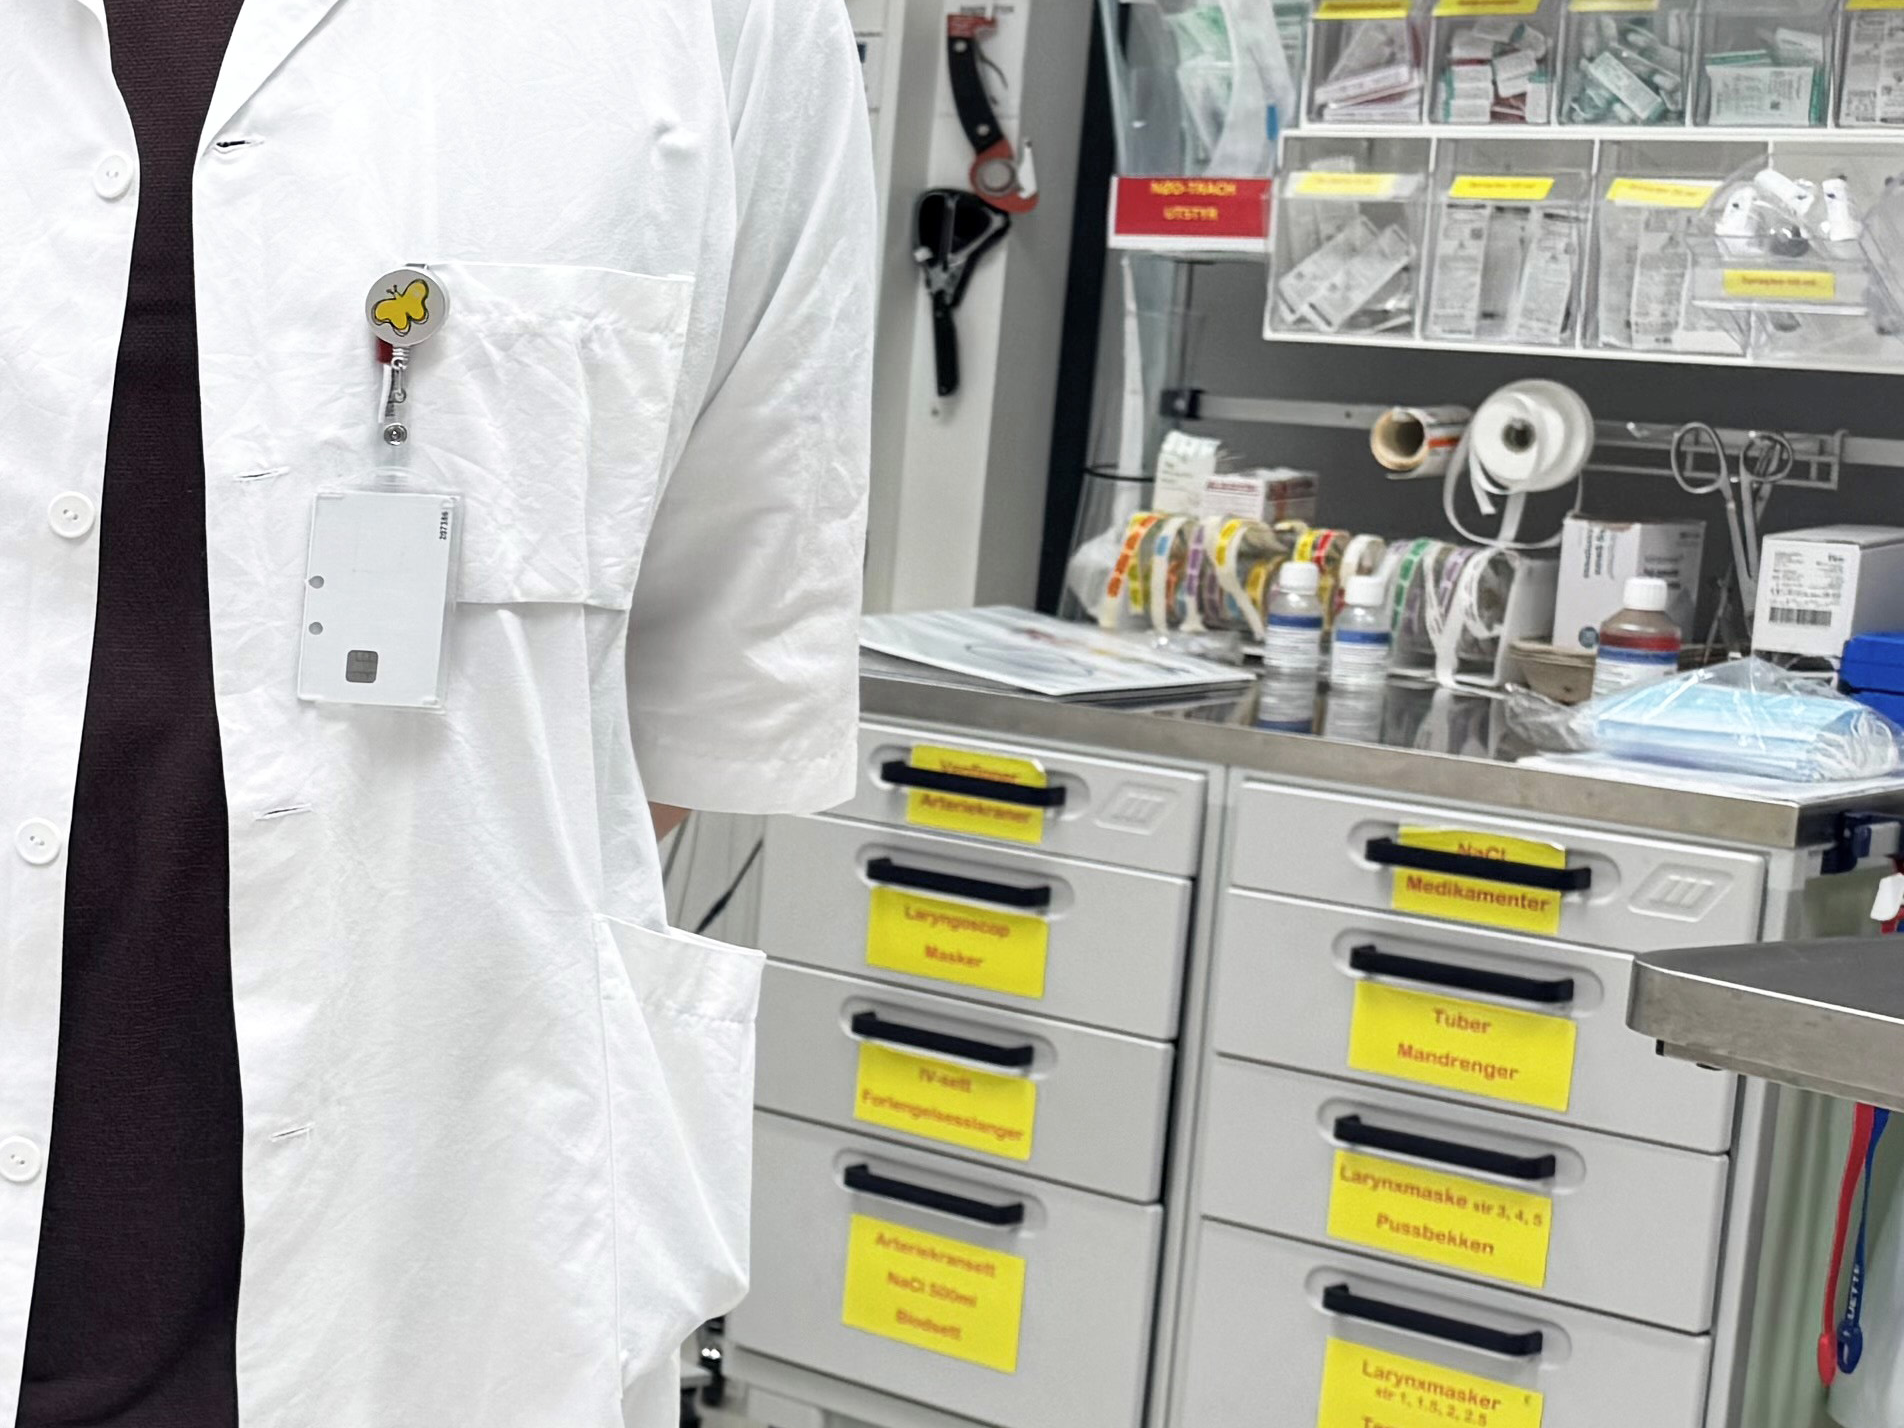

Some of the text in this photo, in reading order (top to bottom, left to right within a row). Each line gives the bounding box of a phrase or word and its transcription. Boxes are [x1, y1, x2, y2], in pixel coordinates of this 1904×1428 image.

[1405, 875, 1551, 912] Medikamenter
[924, 945, 984, 968] Masker
[1433, 1008, 1492, 1034] Tuber
[1397, 1042, 1519, 1081] Mandrenger
[1339, 1165, 1468, 1208] Larynxmaske
[1376, 1212, 1495, 1256] Pussbekken
[1361, 1359, 1502, 1410] Larynxmasker
